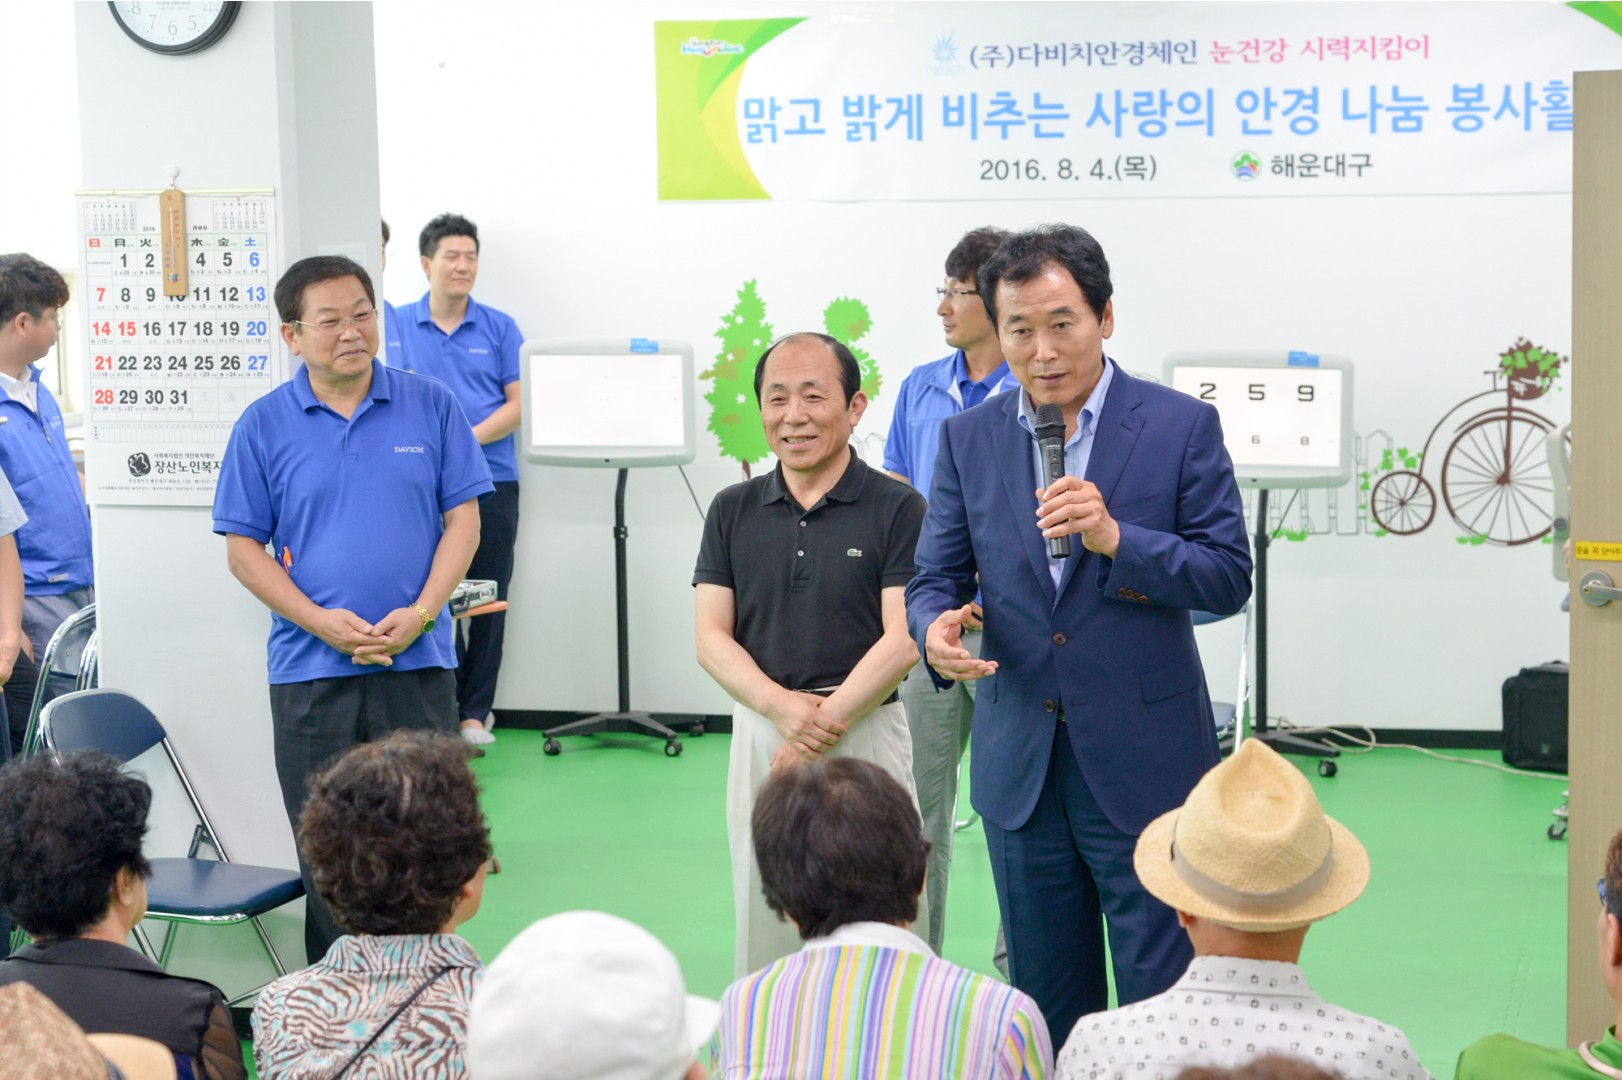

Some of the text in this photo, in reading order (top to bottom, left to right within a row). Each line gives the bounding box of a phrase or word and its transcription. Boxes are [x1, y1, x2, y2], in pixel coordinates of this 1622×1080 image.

[149, 14, 157, 30] 7
[168, 20, 178, 36] 6
[188, 15, 197, 31] 5
[969, 34, 1430, 68] (주)다비치안경체인 눈건강 시력지킴이
[743, 96, 826, 144] 맑고
[842, 93, 924, 142] 밝게
[942, 91, 1071, 141] 비추는
[1085, 87, 1215, 139] 사랑의
[1235, 86, 1320, 136] 안경
[1341, 84, 1430, 135] 나눔
[980, 155, 1157, 181] 2016. 8. 4.(목)
[1270, 153, 1373, 178] 해운대구
[89, 238, 101, 248] 日
[114, 238, 126, 248] 月
[139, 238, 152, 248] 火
[217, 237, 230, 247] 金
[244, 237, 257, 247] 土
[120, 253, 127, 268] 1
[145, 252, 155, 268] 2
[195, 252, 207, 267] 4
[222, 251, 233, 267] 5
[249, 251, 261, 268] 6
[96, 286, 266, 303] 7 8 9 11 12 13
[92, 320, 267, 337] 14 15 16 17 18 19 20
[94, 354, 268, 371] 21 22 23 24 25 26 27
[94, 389, 188, 405] 28 29 30 31
[1199, 382, 1315, 402] 2 5 9
[1251, 434, 1310, 446] 6 8
[394, 446, 424, 454] DAVICH
